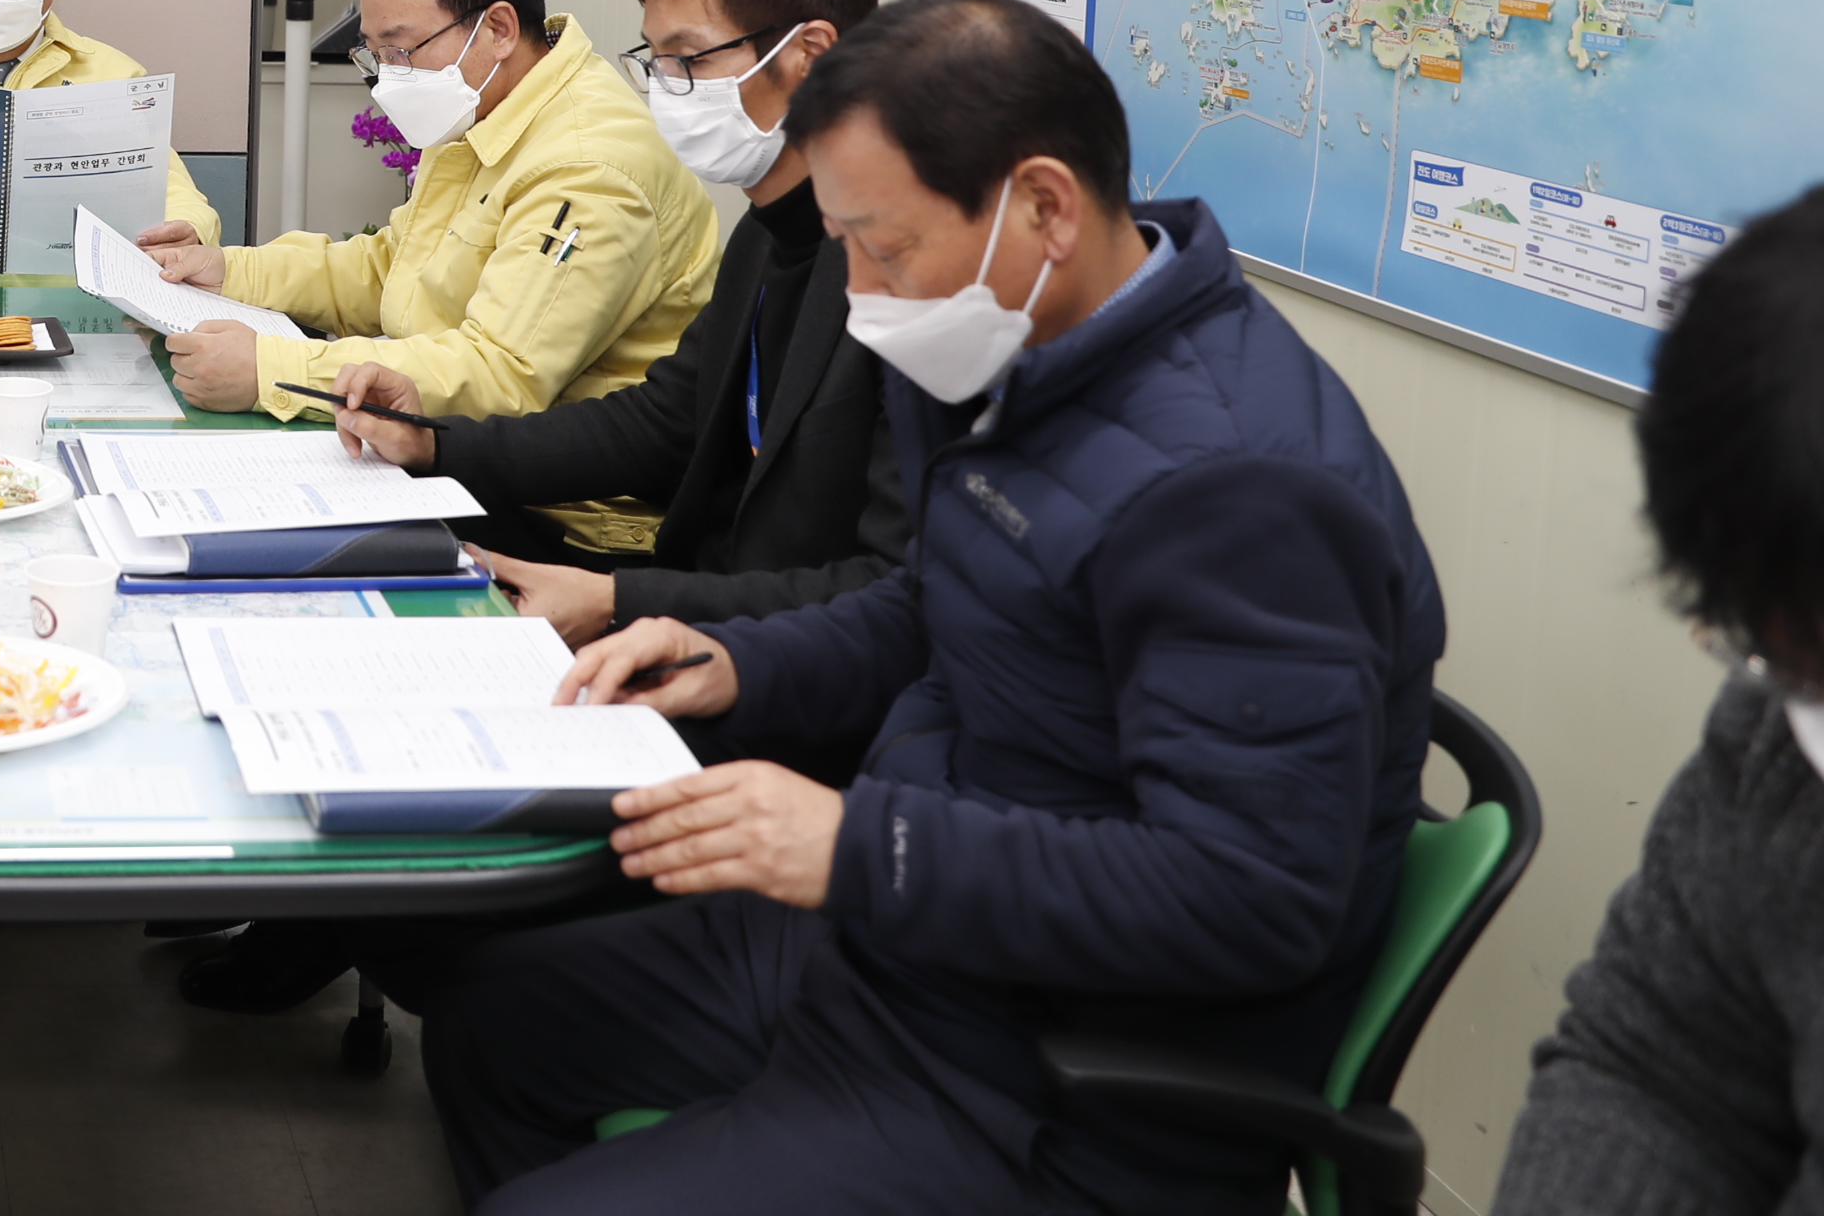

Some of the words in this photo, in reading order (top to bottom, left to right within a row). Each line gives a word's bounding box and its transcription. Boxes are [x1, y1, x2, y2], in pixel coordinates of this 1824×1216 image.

[130, 81, 164, 93] 군수님
[32, 161, 63, 172] 관광과
[70, 158, 110, 170] 현안업무
[117, 153, 146, 166] 간담회
[1417, 164, 1430, 178] 진도
[1431, 168, 1458, 184] 여행코스
